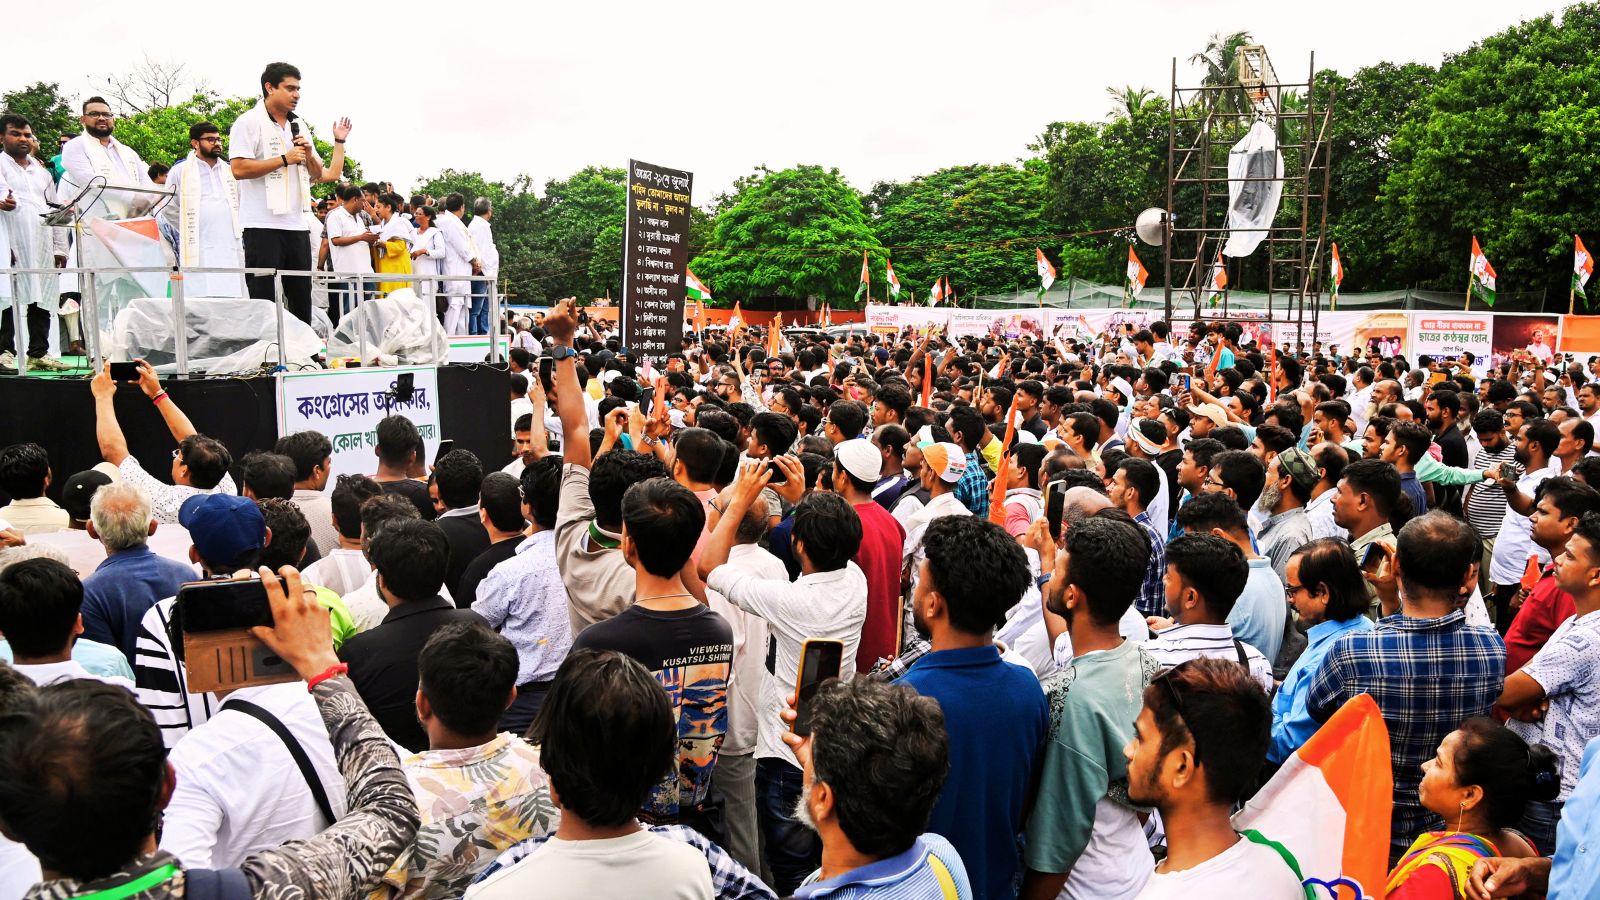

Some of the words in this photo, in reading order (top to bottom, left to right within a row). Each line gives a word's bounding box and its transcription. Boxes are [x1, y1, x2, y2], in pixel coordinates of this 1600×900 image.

[671, 171, 690, 192] জুলাই
[647, 188, 673, 201] তোমাদের
[673, 193, 690, 204] আমরা
[652, 202, 659, 212] না
[678, 206, 685, 216] না
[658, 288, 668, 297] দাস
[658, 315, 668, 323] দাস
[1419, 332, 1441, 343] ছাত্রের
[1443, 331, 1469, 344] কণ্ঠস্বর
[296, 392, 369, 420] কংগ্রেসের
[333, 432, 362, 453] কোল
[690, 645, 719, 655] VIEWS
